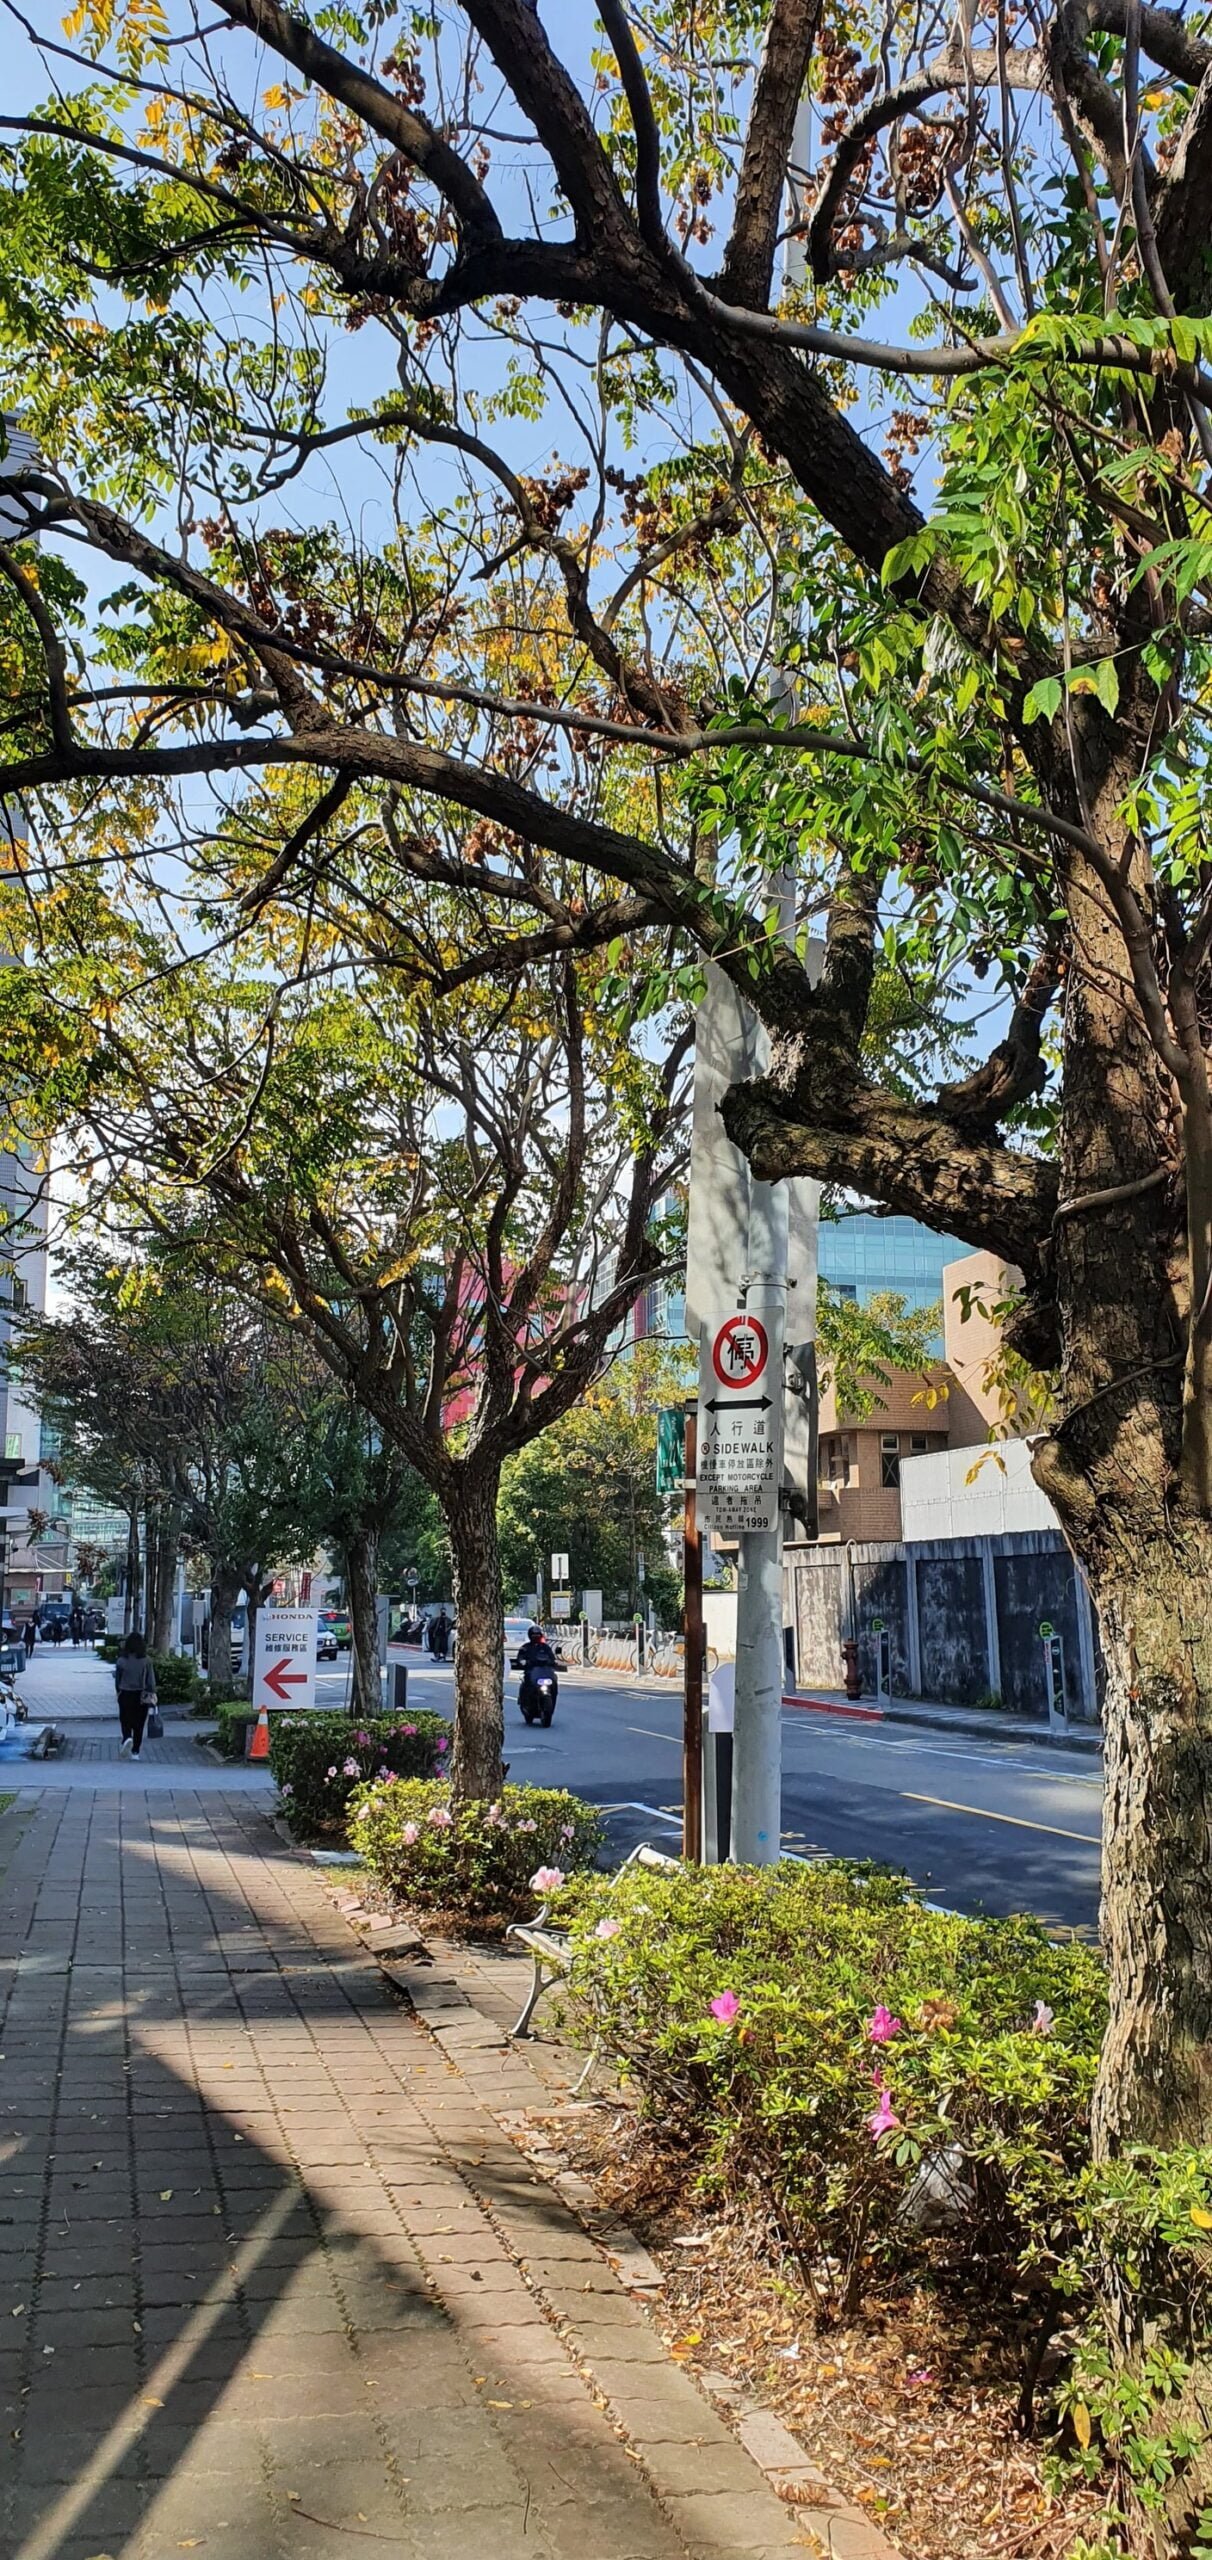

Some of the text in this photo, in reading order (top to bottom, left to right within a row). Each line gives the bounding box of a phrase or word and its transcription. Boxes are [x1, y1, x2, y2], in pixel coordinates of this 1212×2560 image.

[727, 1333, 755, 1371] 停
[710, 1420, 766, 1436] 人行道
[713, 1441, 774, 1454] SIDEWALK
[700, 1472, 775, 1482] EXCEPT MOTORCYCLE
[709, 1484, 763, 1493] PARKING AREA
[745, 1516, 769, 1529] 1999
